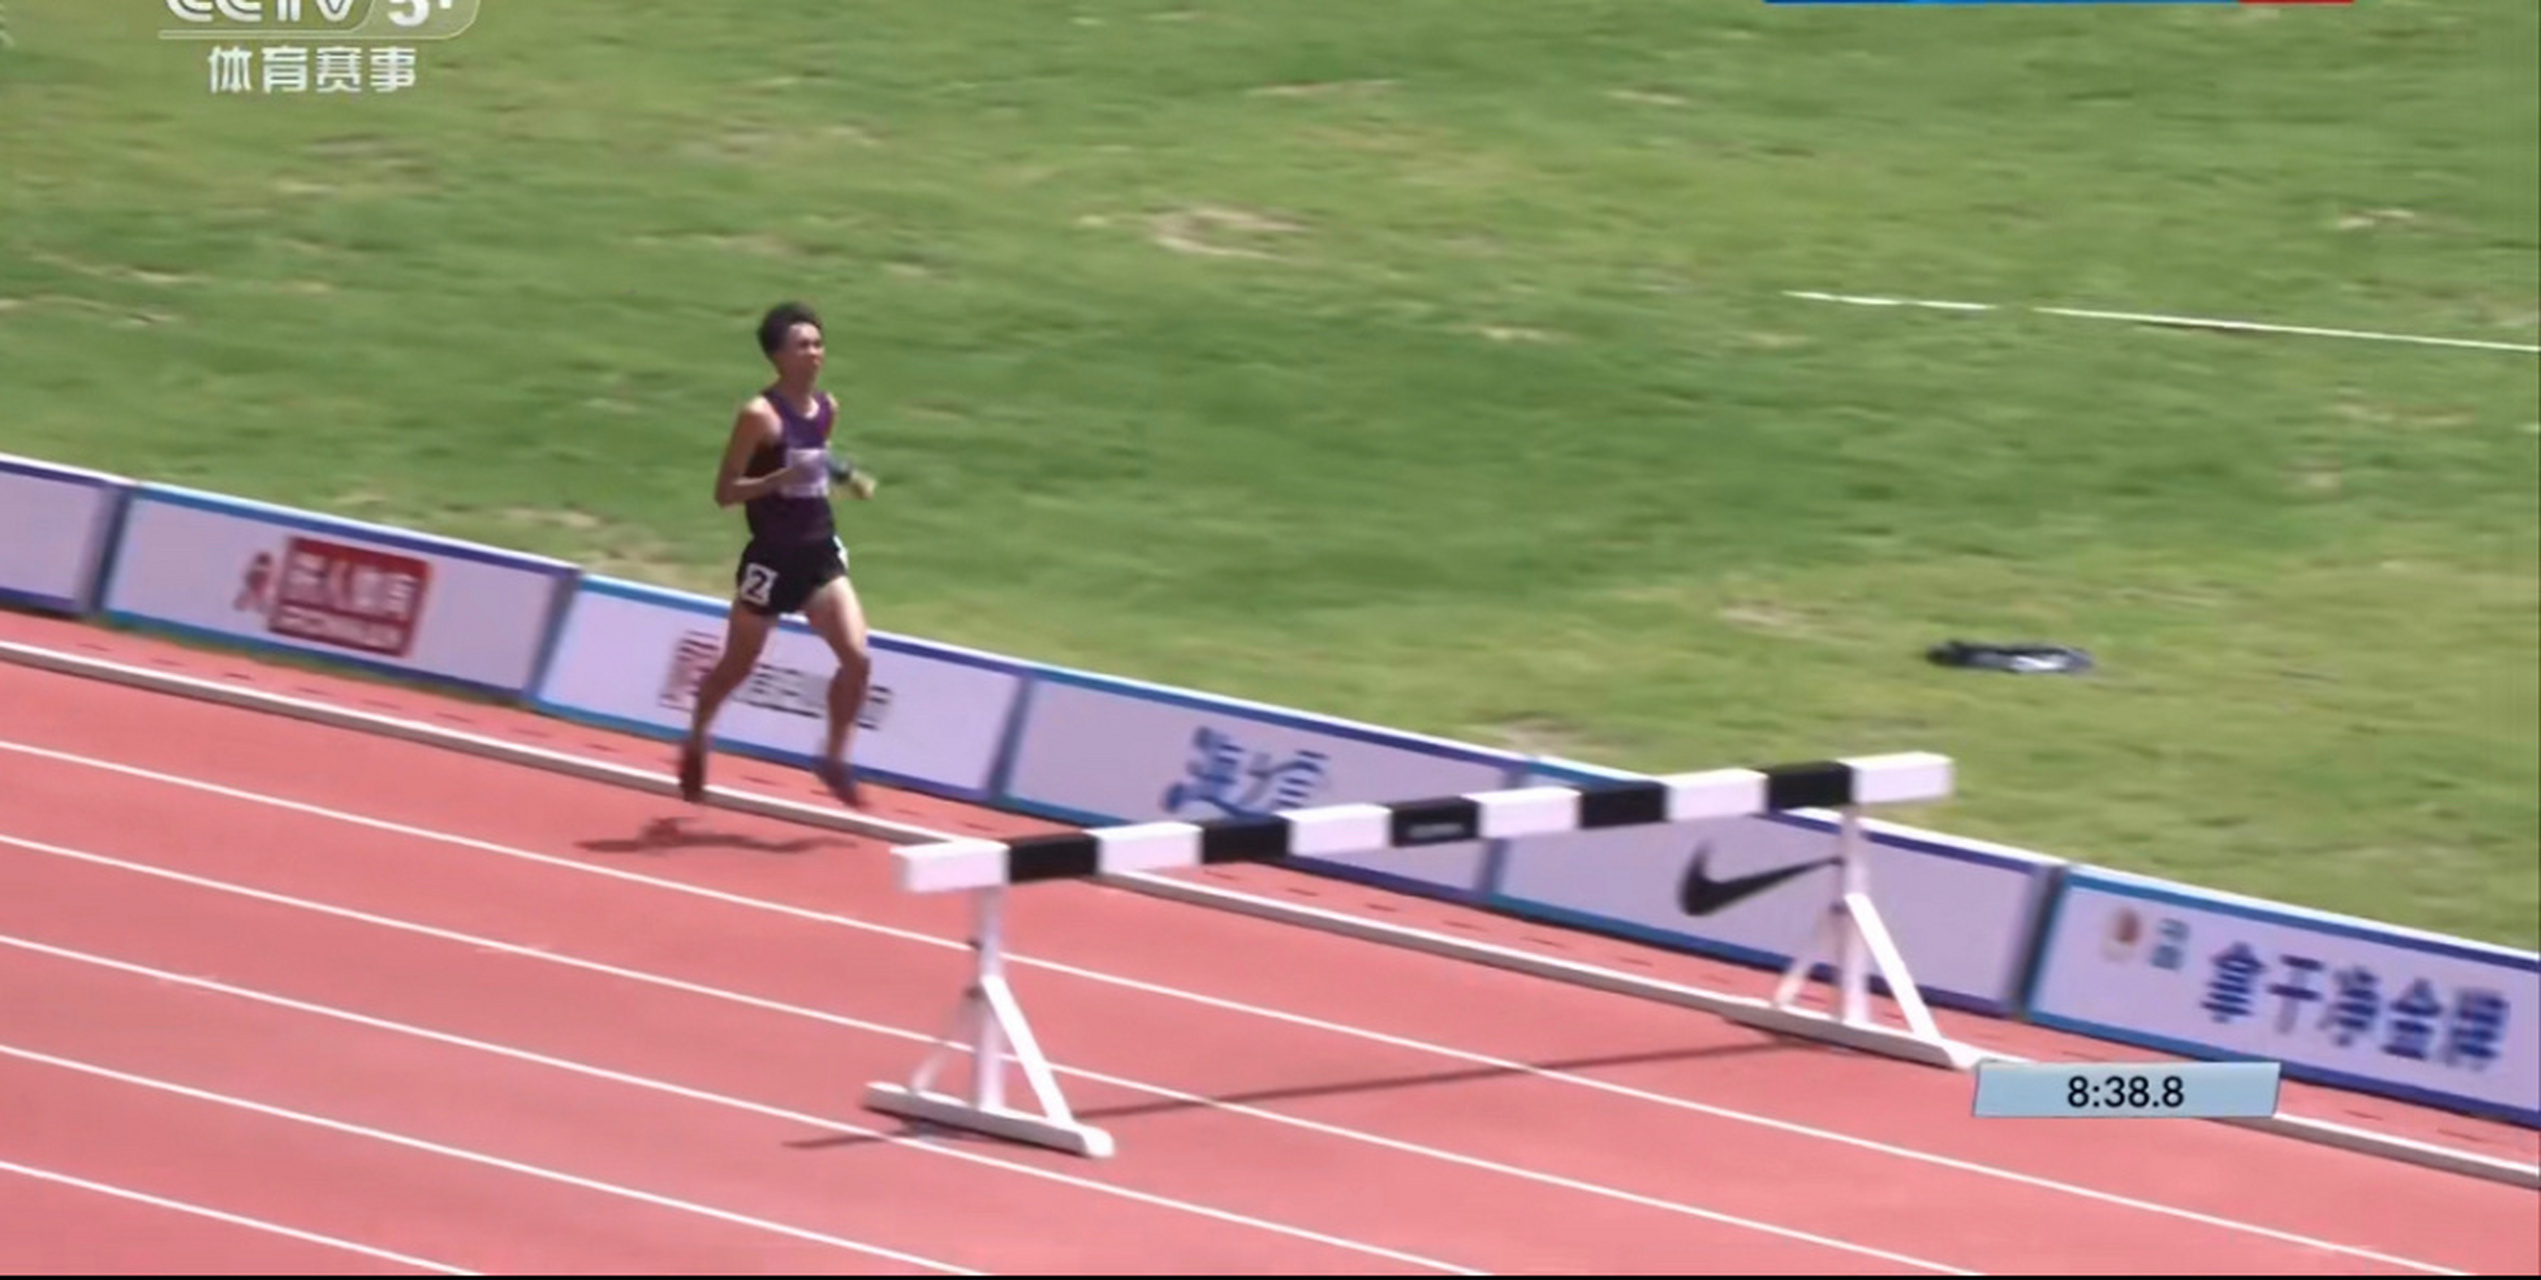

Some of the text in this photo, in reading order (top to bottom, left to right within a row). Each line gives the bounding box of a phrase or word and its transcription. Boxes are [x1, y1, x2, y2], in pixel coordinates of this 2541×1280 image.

[746, 569, 769, 600] 2
[2200, 940, 2511, 1072] 拿干净金牌
